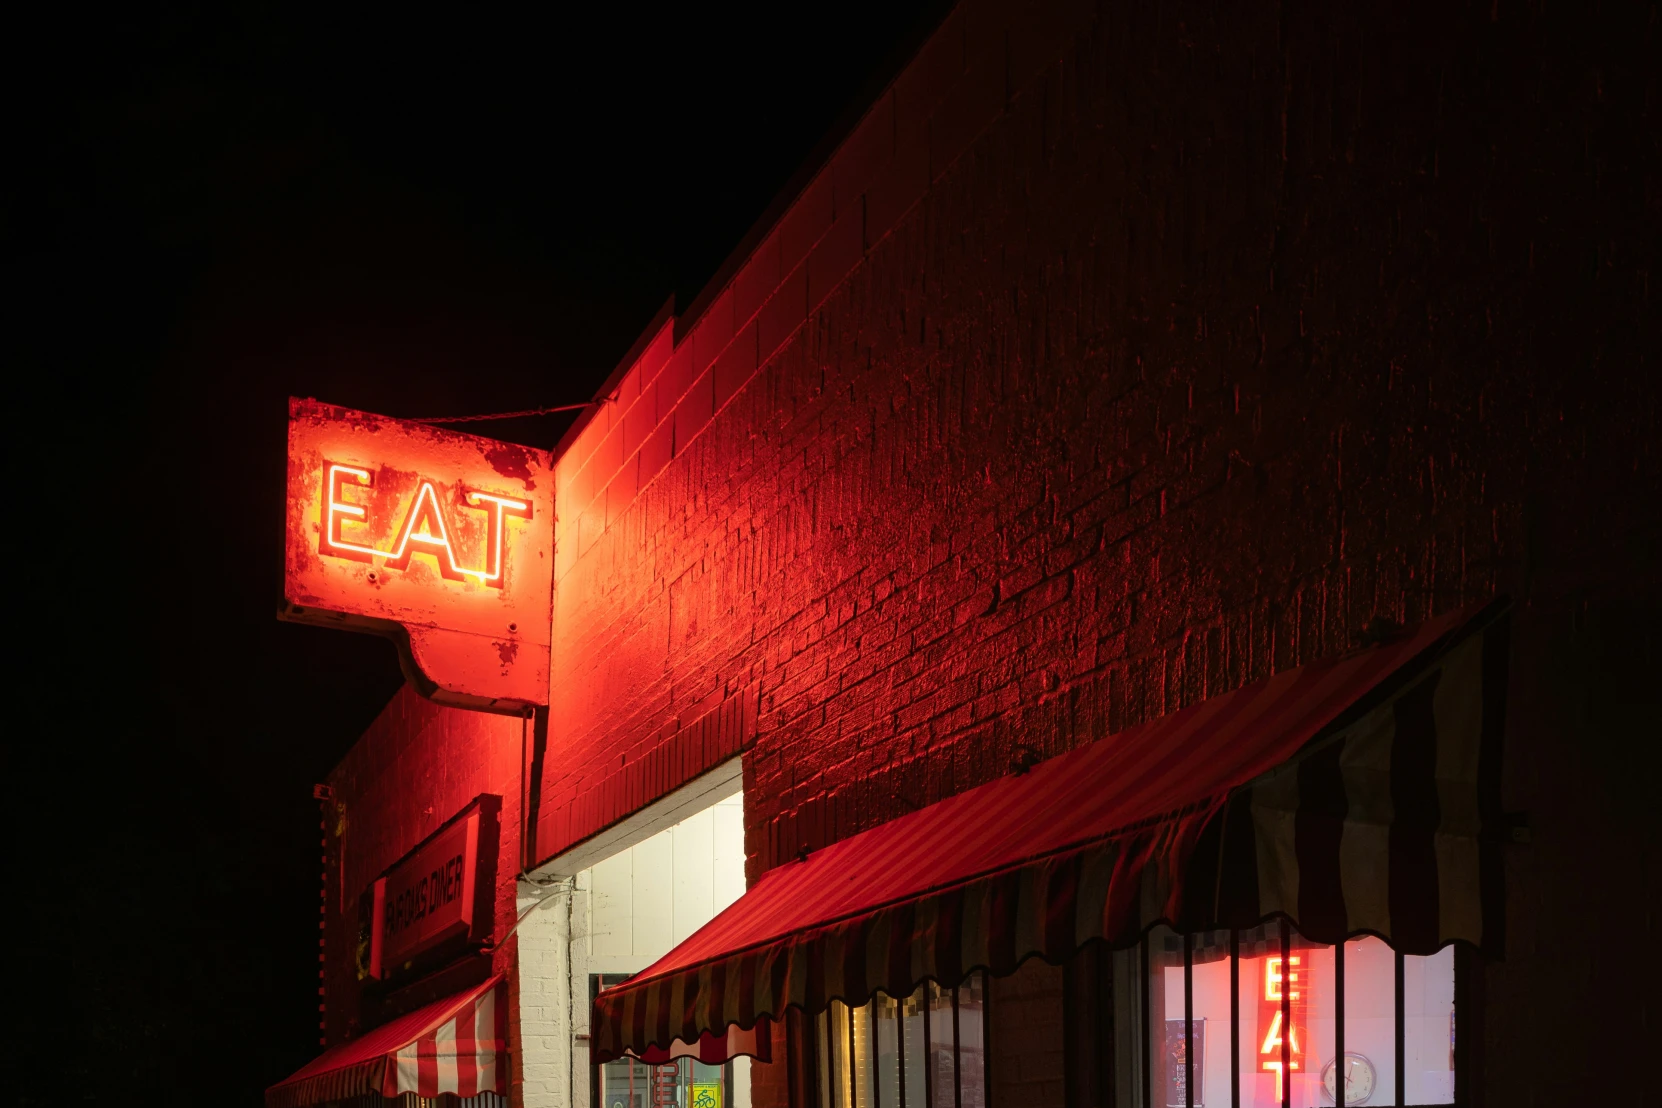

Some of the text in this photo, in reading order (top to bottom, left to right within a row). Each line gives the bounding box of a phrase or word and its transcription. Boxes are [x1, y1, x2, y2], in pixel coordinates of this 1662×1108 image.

[320, 460, 533, 589] EAT
[429, 854, 463, 914] DINER
[1260, 956, 1301, 1104] EAT
